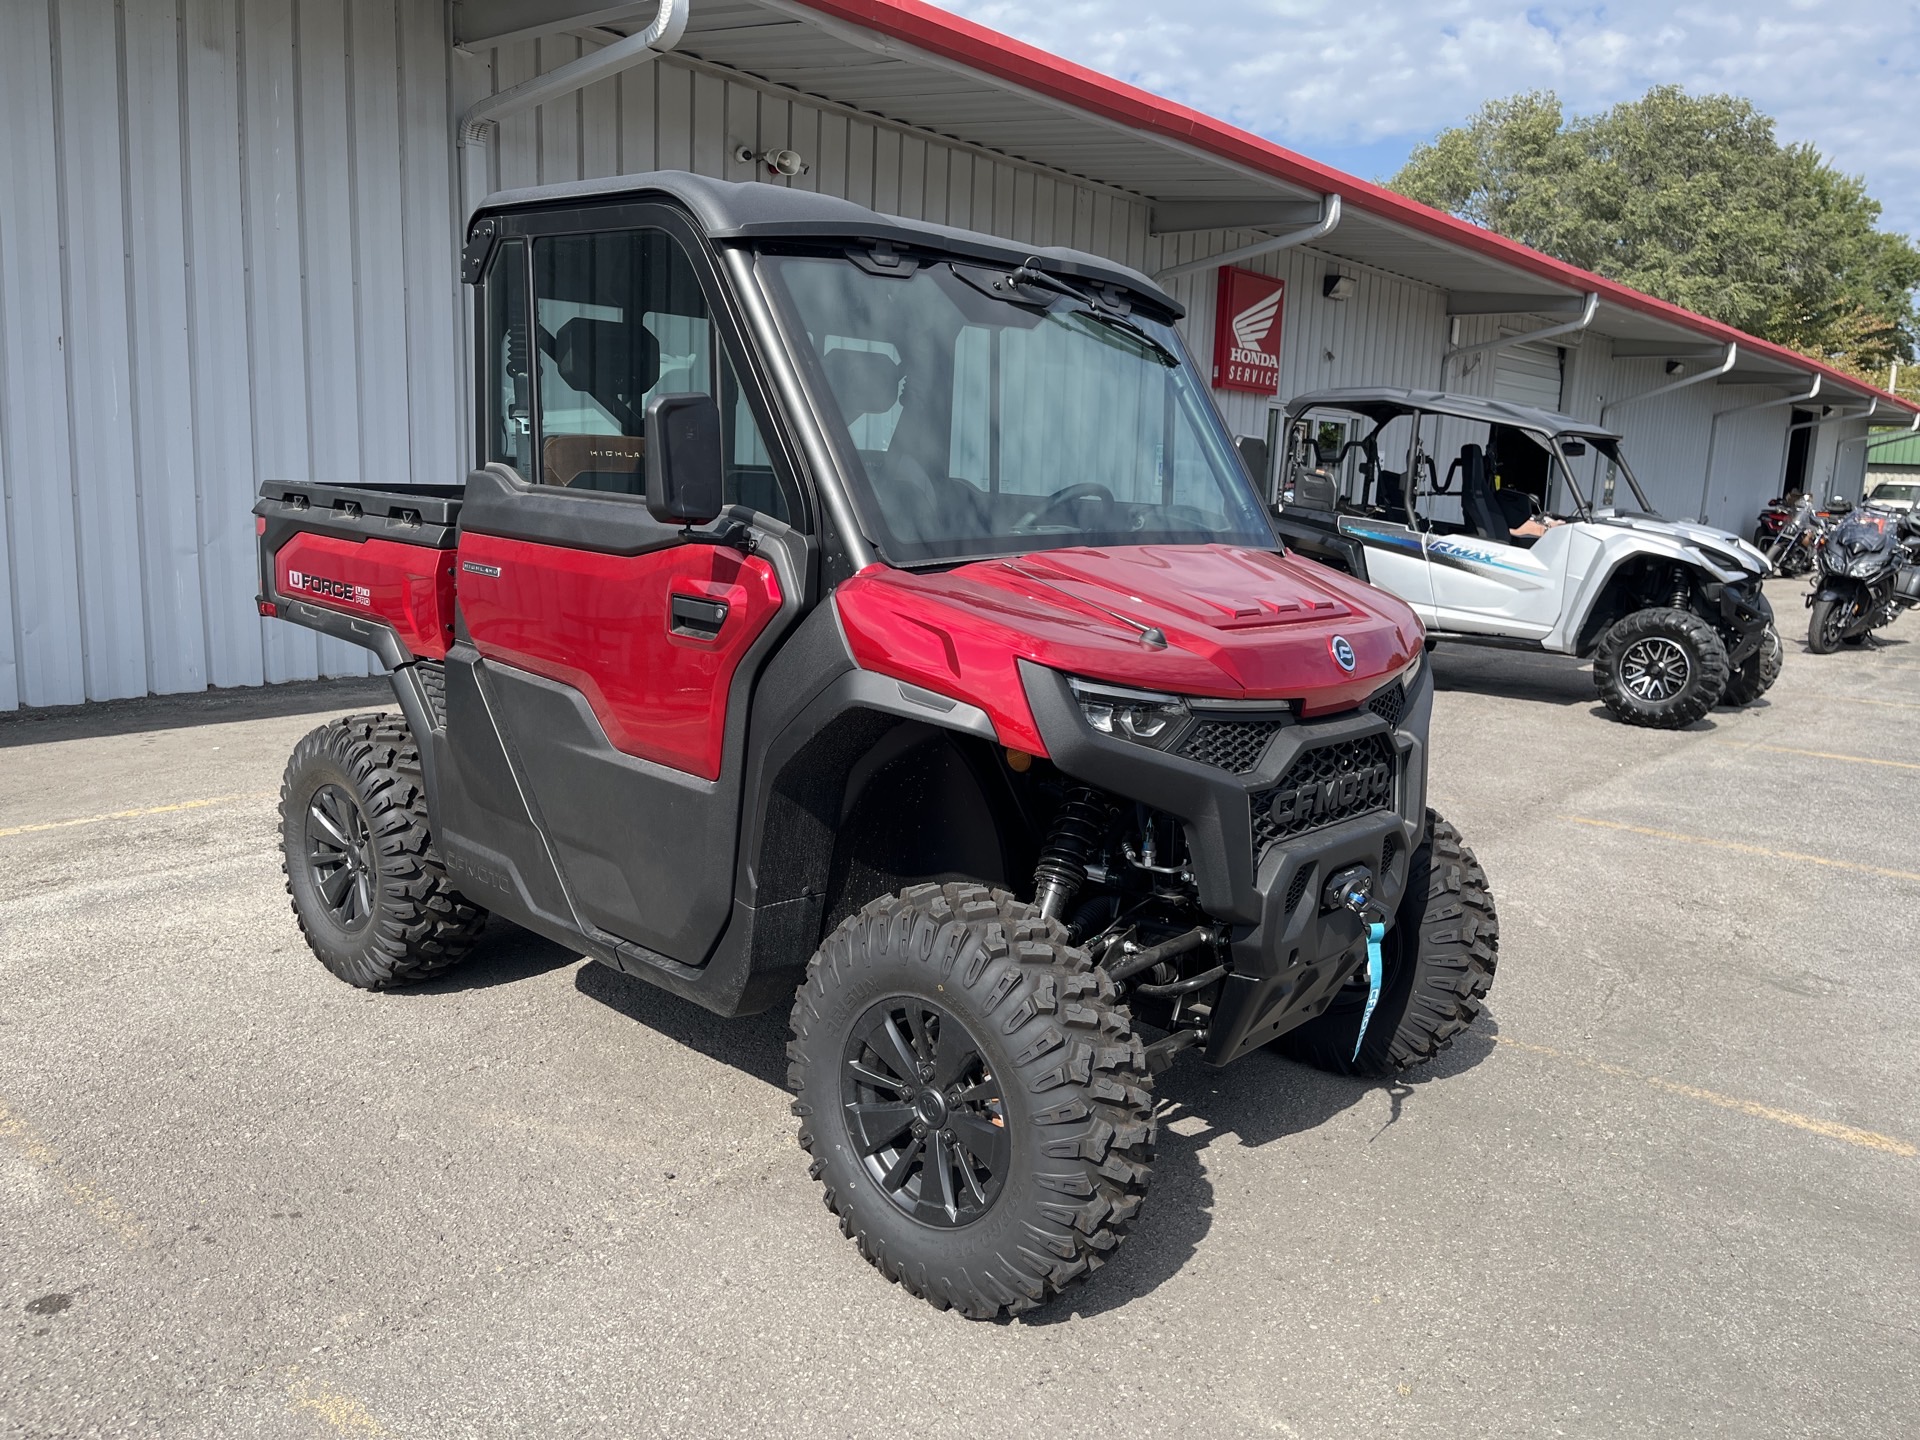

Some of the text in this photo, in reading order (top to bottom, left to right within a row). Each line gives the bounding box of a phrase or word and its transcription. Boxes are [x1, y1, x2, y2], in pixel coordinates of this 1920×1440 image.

[1230, 346, 1279, 369] HONDA
[1228, 365, 1279, 386] SERVICE
[589, 450, 645, 458] HIGHLA
[464, 563, 498, 575] HIGHLAND
[355, 595, 371, 606] PRO
[1271, 763, 1390, 824] CFMOTO
